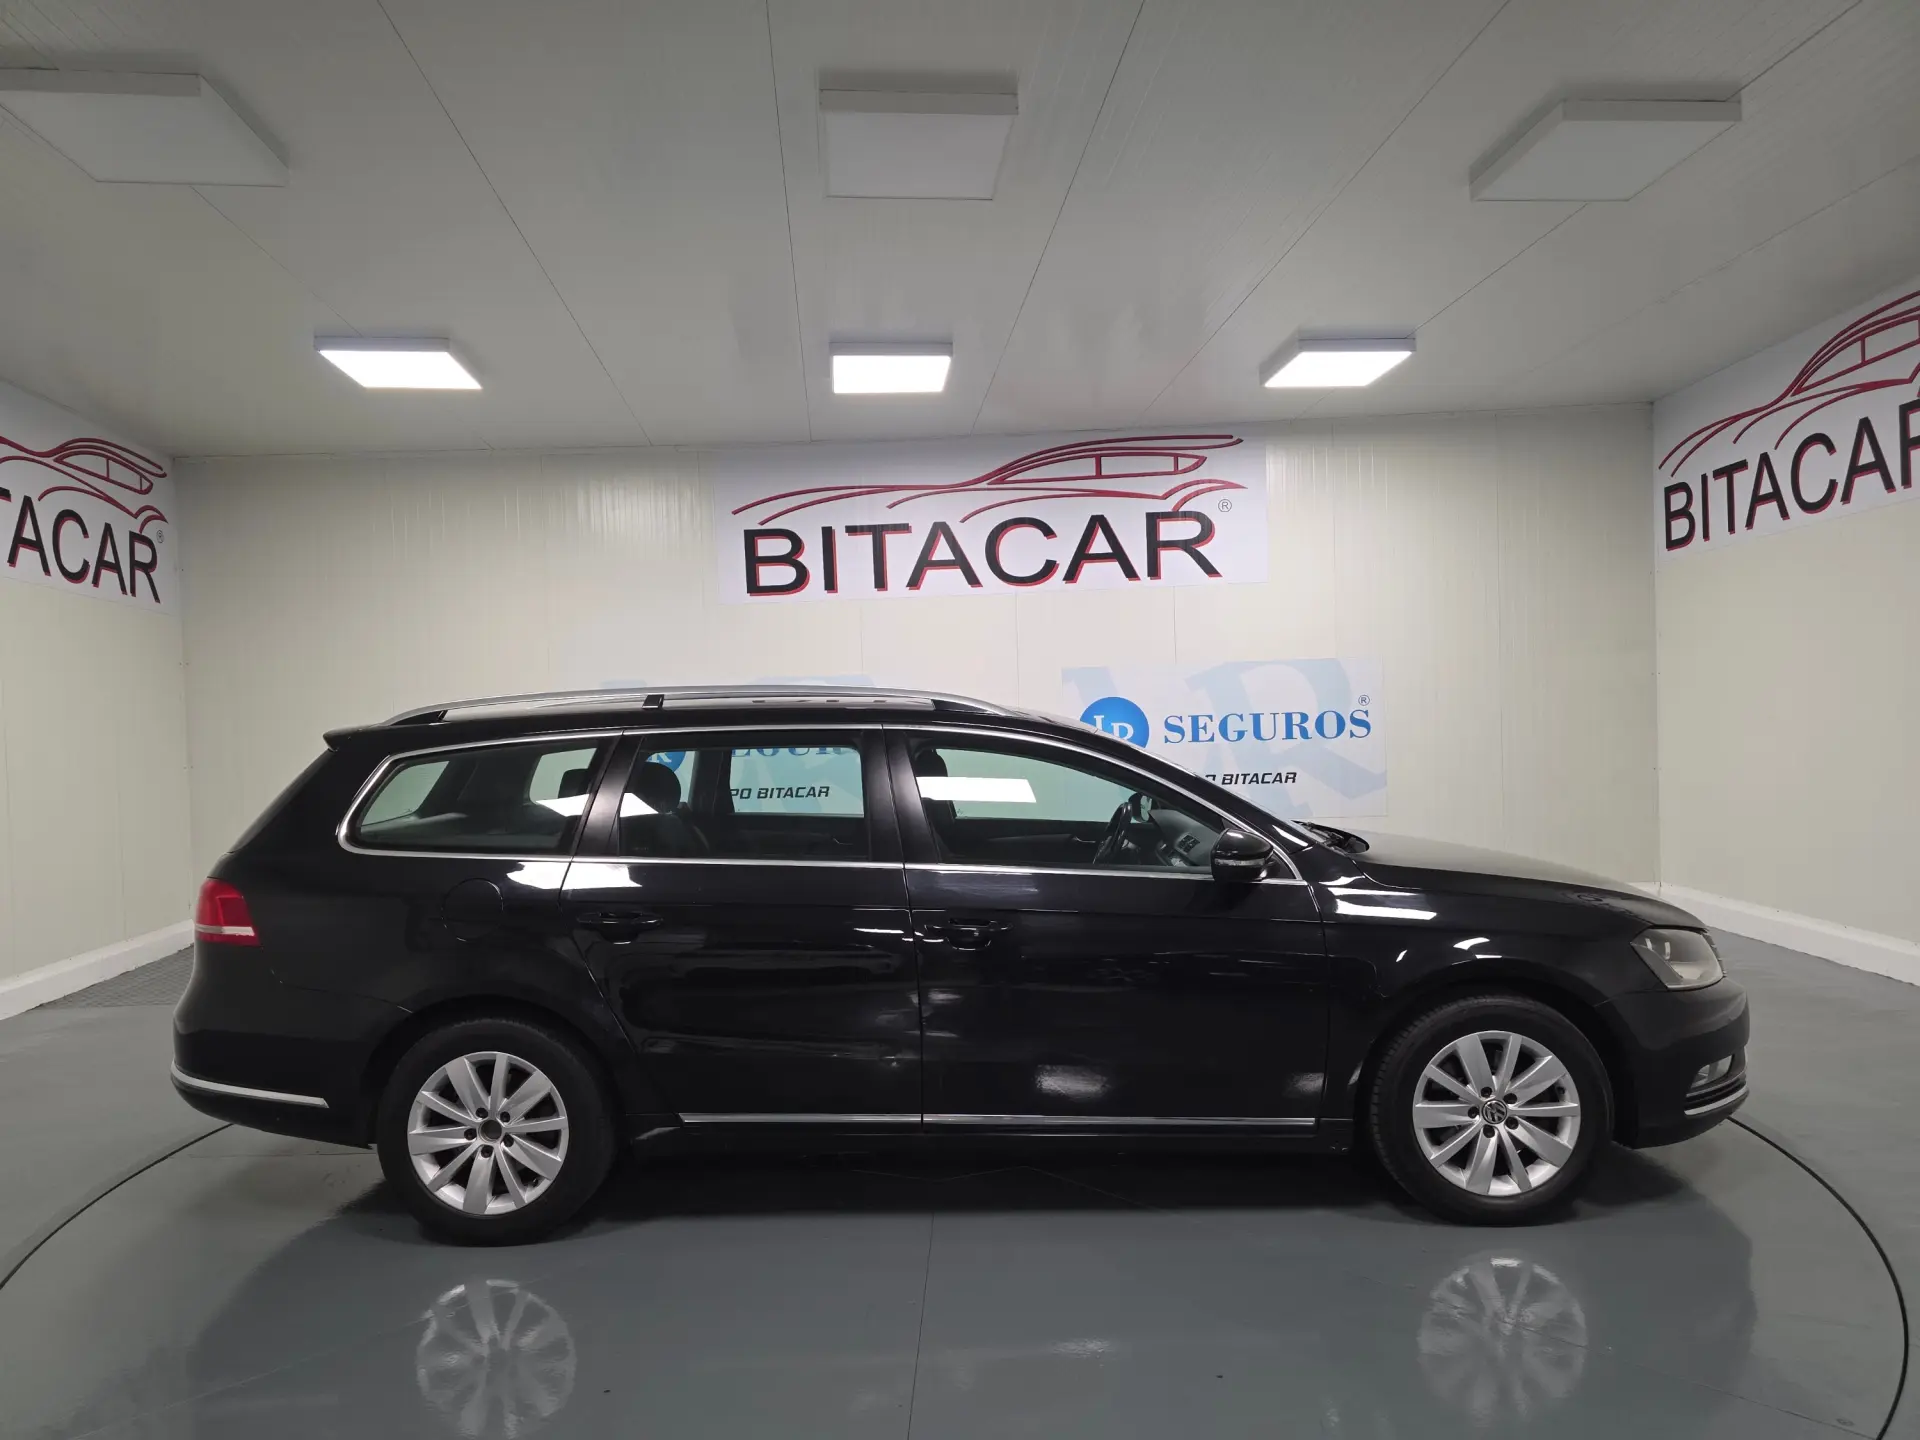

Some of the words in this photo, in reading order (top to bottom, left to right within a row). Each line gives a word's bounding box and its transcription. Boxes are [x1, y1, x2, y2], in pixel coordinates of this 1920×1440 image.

[744, 510, 1223, 596] BITACAR
[1163, 709, 1372, 744] SEGUROS
[1221, 771, 1297, 786] BITACAR
[757, 786, 830, 799] BITACAR
